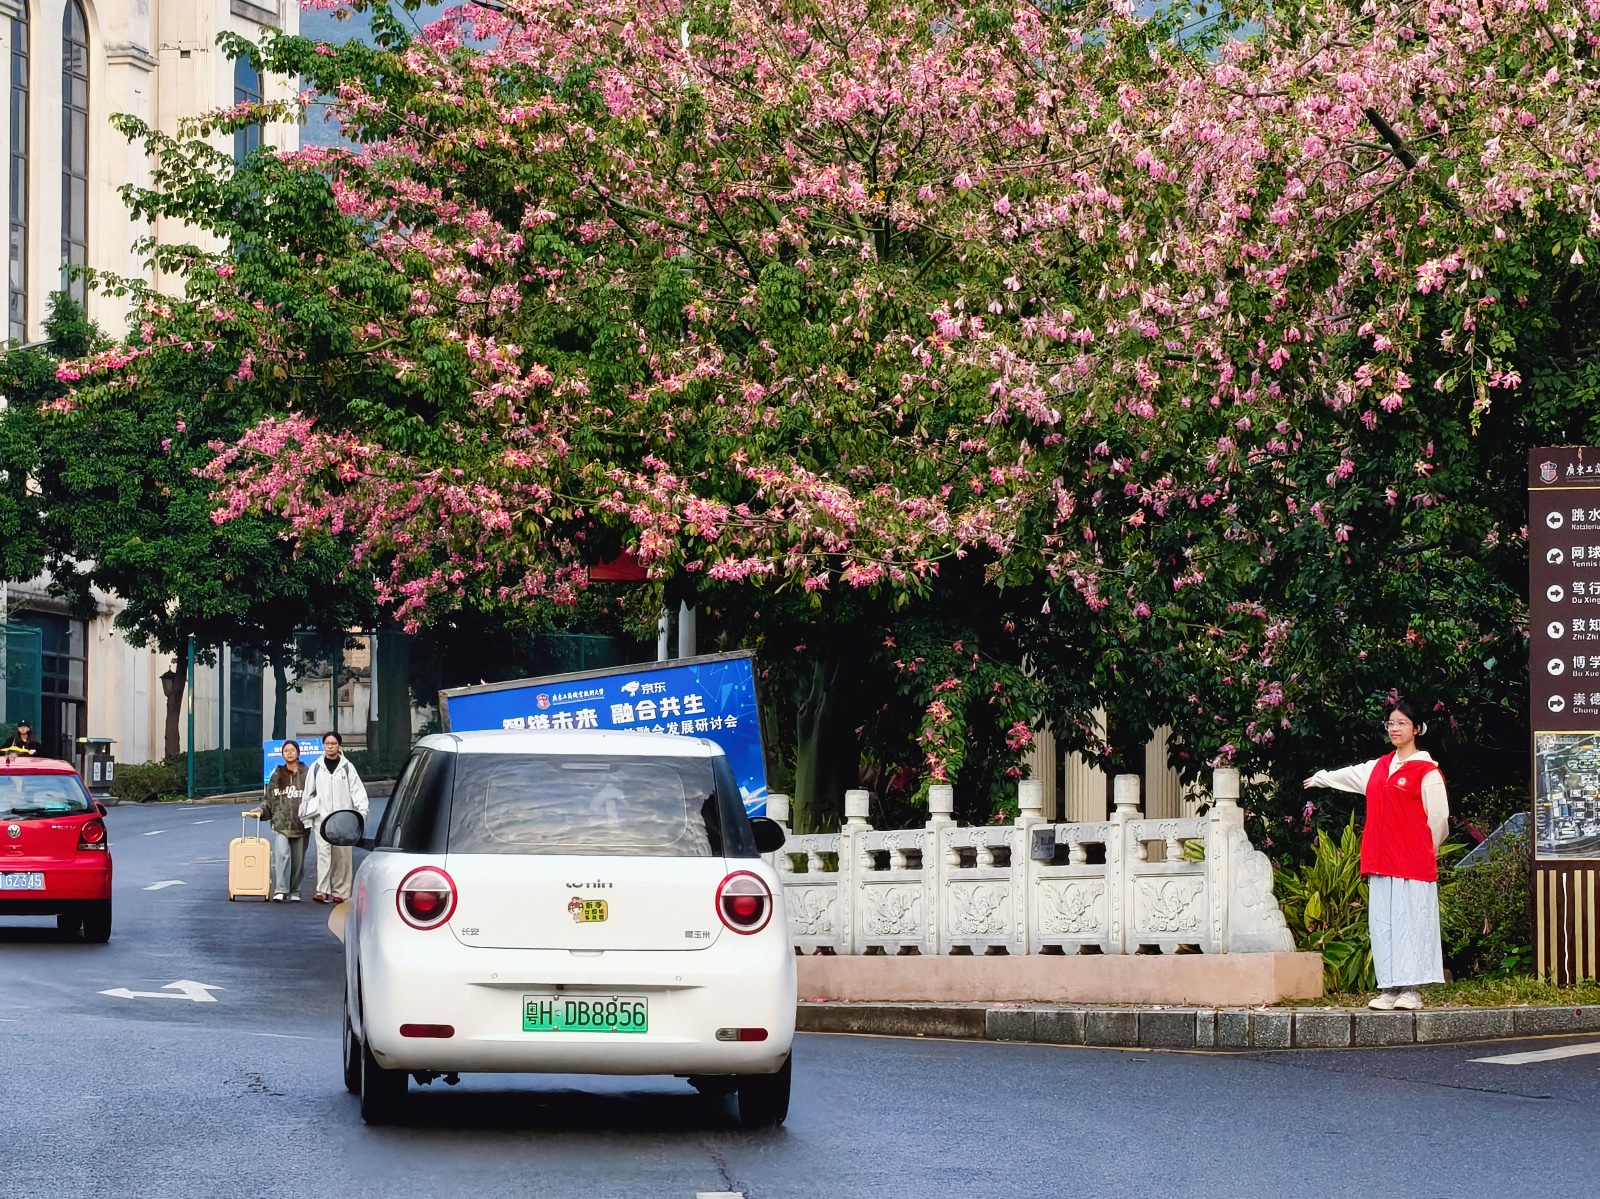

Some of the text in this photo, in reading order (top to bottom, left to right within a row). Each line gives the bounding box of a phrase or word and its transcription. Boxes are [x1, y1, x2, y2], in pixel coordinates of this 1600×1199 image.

[1571, 508, 1600, 522] 跳水
[1571, 546, 1600, 559] 网球
[1572, 581, 1600, 595] 笃行
[1572, 596, 1583, 604] Du
[1572, 618, 1600, 632] 致知
[1572, 633, 1599, 641] Zhi Zhi
[1572, 655, 1600, 669] 博学
[641, 682, 667, 695] 京东
[1573, 692, 1600, 706] 崇德
[610, 694, 706, 725] 融合共生
